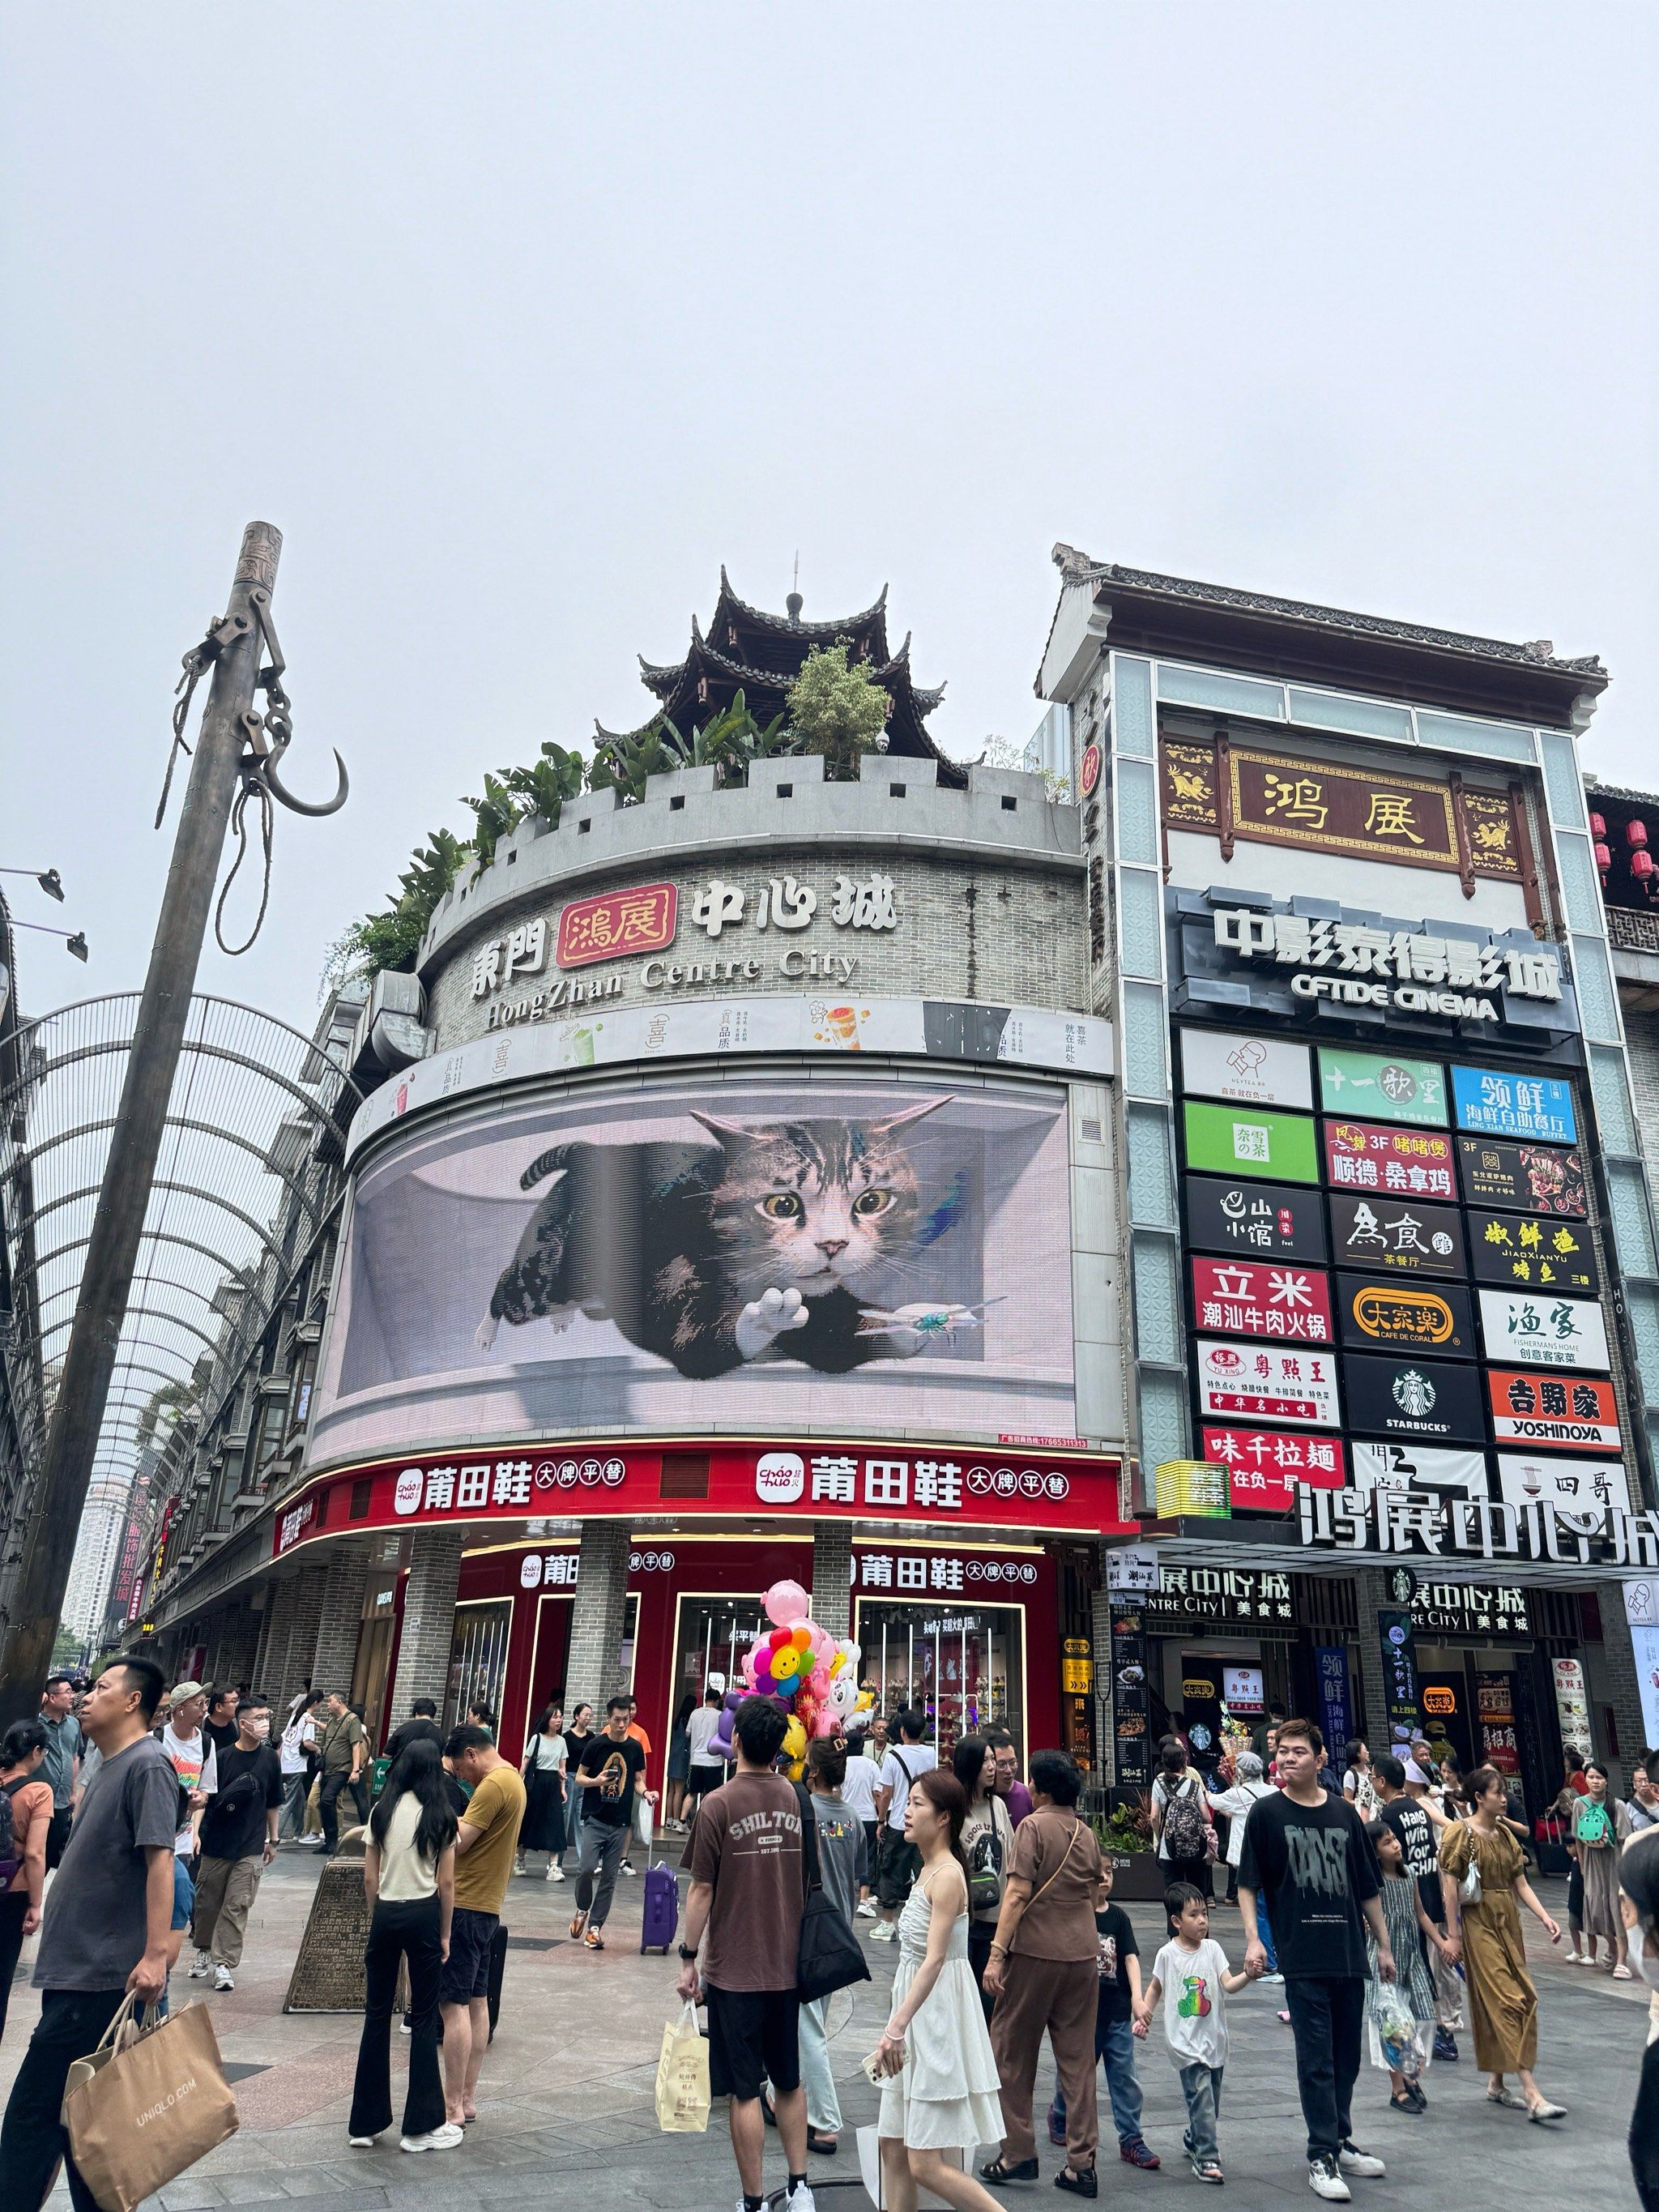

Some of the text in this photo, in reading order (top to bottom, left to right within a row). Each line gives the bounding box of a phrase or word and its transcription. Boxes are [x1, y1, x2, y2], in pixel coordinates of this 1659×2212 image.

[1264, 773, 1424, 844] 鸿展
[470, 917, 548, 999] 東門
[692, 874, 897, 938] 中心城
[1213, 908, 1564, 1001] 中影泰得影城
[487, 948, 859, 1030] HongZhan Centre City
[1290, 973, 1499, 1022] CFTIDE CINEMA
[1065, 1023, 1075, 1063] 就在此处
[1077, 1025, 1086, 1045] 喜茶
[1481, 1076, 1546, 1113] 领鲜
[1466, 1104, 1565, 1133] 海鲜自助餐厅
[1468, 1121, 1567, 1140] LING XIAN SEAFOOD BUFFET
[1370, 1135, 1389, 1150] 3F
[1463, 1142, 1478, 1152] 3F
[1226, 1220, 1273, 1246] 小馆
[1280, 1210, 1291, 1233] 川菜
[1384, 1253, 1420, 1267] 茶餐厅
[1512, 1260, 1556, 1283] 烤鱼
[1213, 1266, 1312, 1307] 立米
[1571, 1275, 1589, 1286] 三楼
[1203, 1301, 1326, 1339] 潮汕牛肉火锅
[1508, 1301, 1583, 1339] 渔家
[1410, 1334, 1433, 1343] CORAL
[1513, 1339, 1558, 1350] FISHERMANS
[1520, 1348, 1576, 1364] 创意客家菜
[1207, 1380, 1236, 1390] 特色点心
[1275, 1387, 1303, 1398] 牛排简餐
[1308, 1390, 1330, 1400] 特色菜
[1214, 1394, 1310, 1416] 中华名小吃
[1386, 1419, 1448, 1433] STARBUCKS
[1512, 1420, 1602, 1442] YOSHINOYA
[536, 1459, 625, 1488] 大牌平替
[811, 1456, 962, 1508] 莆田鞋
[967, 1467, 1068, 1499] 大牌平替
[424, 1461, 532, 1510] 莆田鞋
[1555, 1472, 1613, 1506] 四哥
[862, 1555, 963, 1591] 莆田鞋
[966, 1561, 1037, 1584] 大牌平替
[1237, 1601, 1292, 1618] 美食城
[1477, 1615, 1529, 1631] 美食城
[1322, 1654, 1345, 1702] 领鲜
[1399, 1809, 1427, 1829] Hang
[965, 1823, 983, 1843] space
[1408, 1843, 1430, 1860] Your
[136, 2077, 197, 2126] UNIQLO.COM
